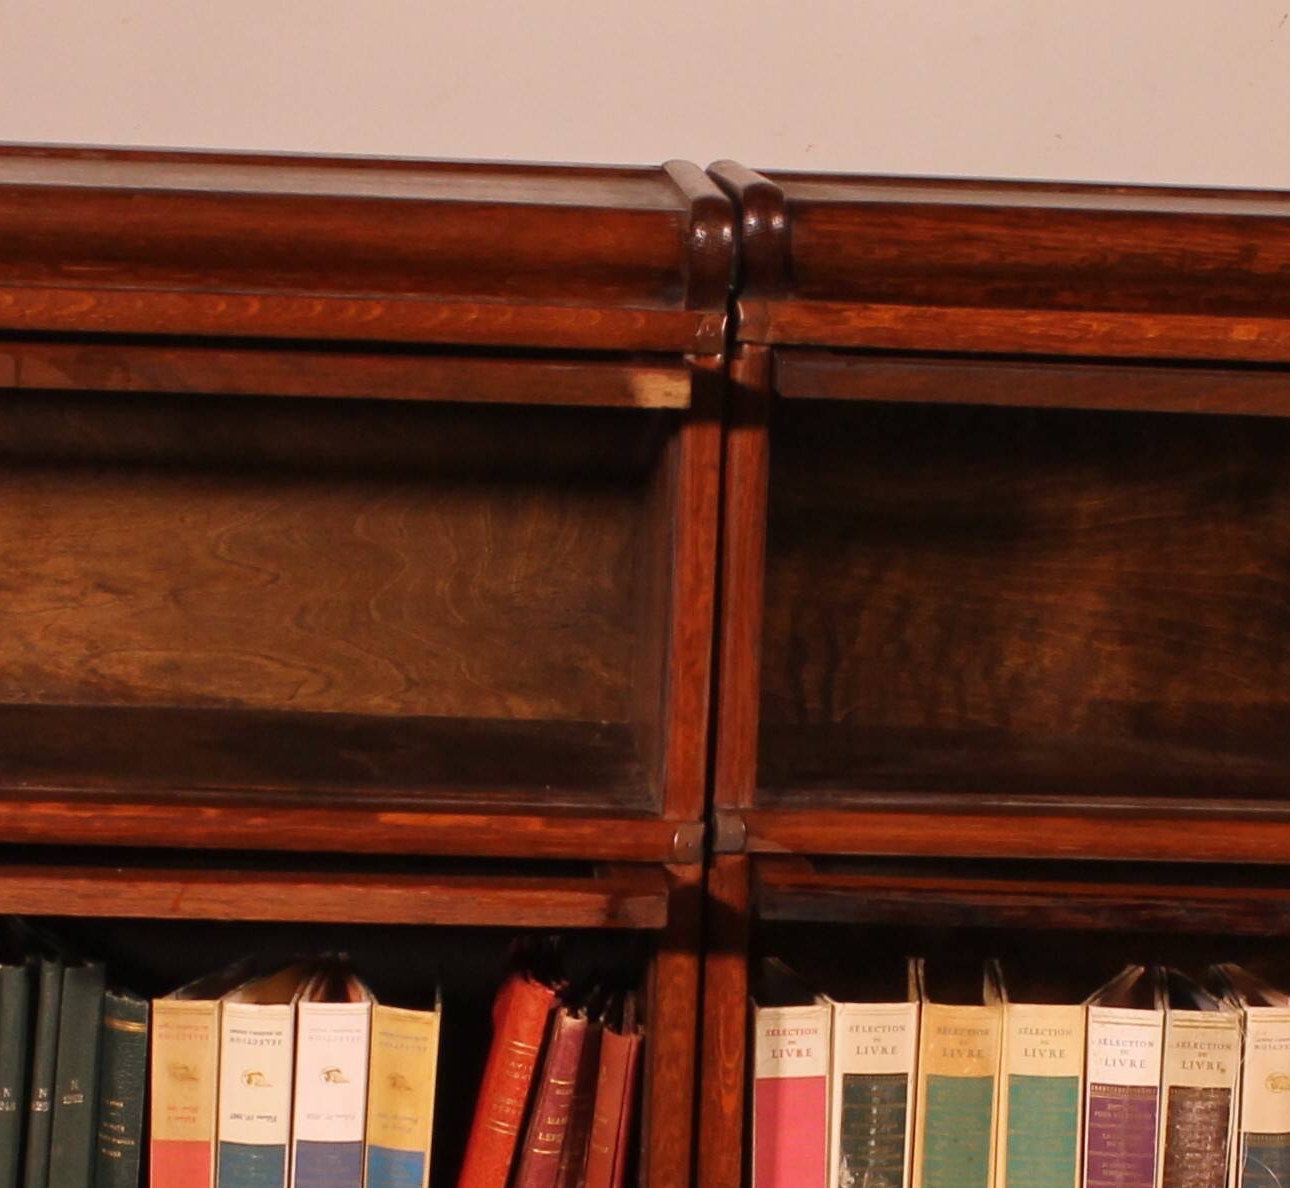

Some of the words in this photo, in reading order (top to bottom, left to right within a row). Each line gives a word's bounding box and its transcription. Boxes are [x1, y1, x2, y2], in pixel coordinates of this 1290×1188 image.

[771, 1047, 813, 1059] LIVRE
[856, 1045, 899, 1056] LIVRE
[941, 1048, 985, 1058] LIVRE
[1024, 1048, 1068, 1058] LIVRE
[1104, 1058, 1148, 1069] LIVRE
[1181, 1060, 1223, 1071] LIVRE
